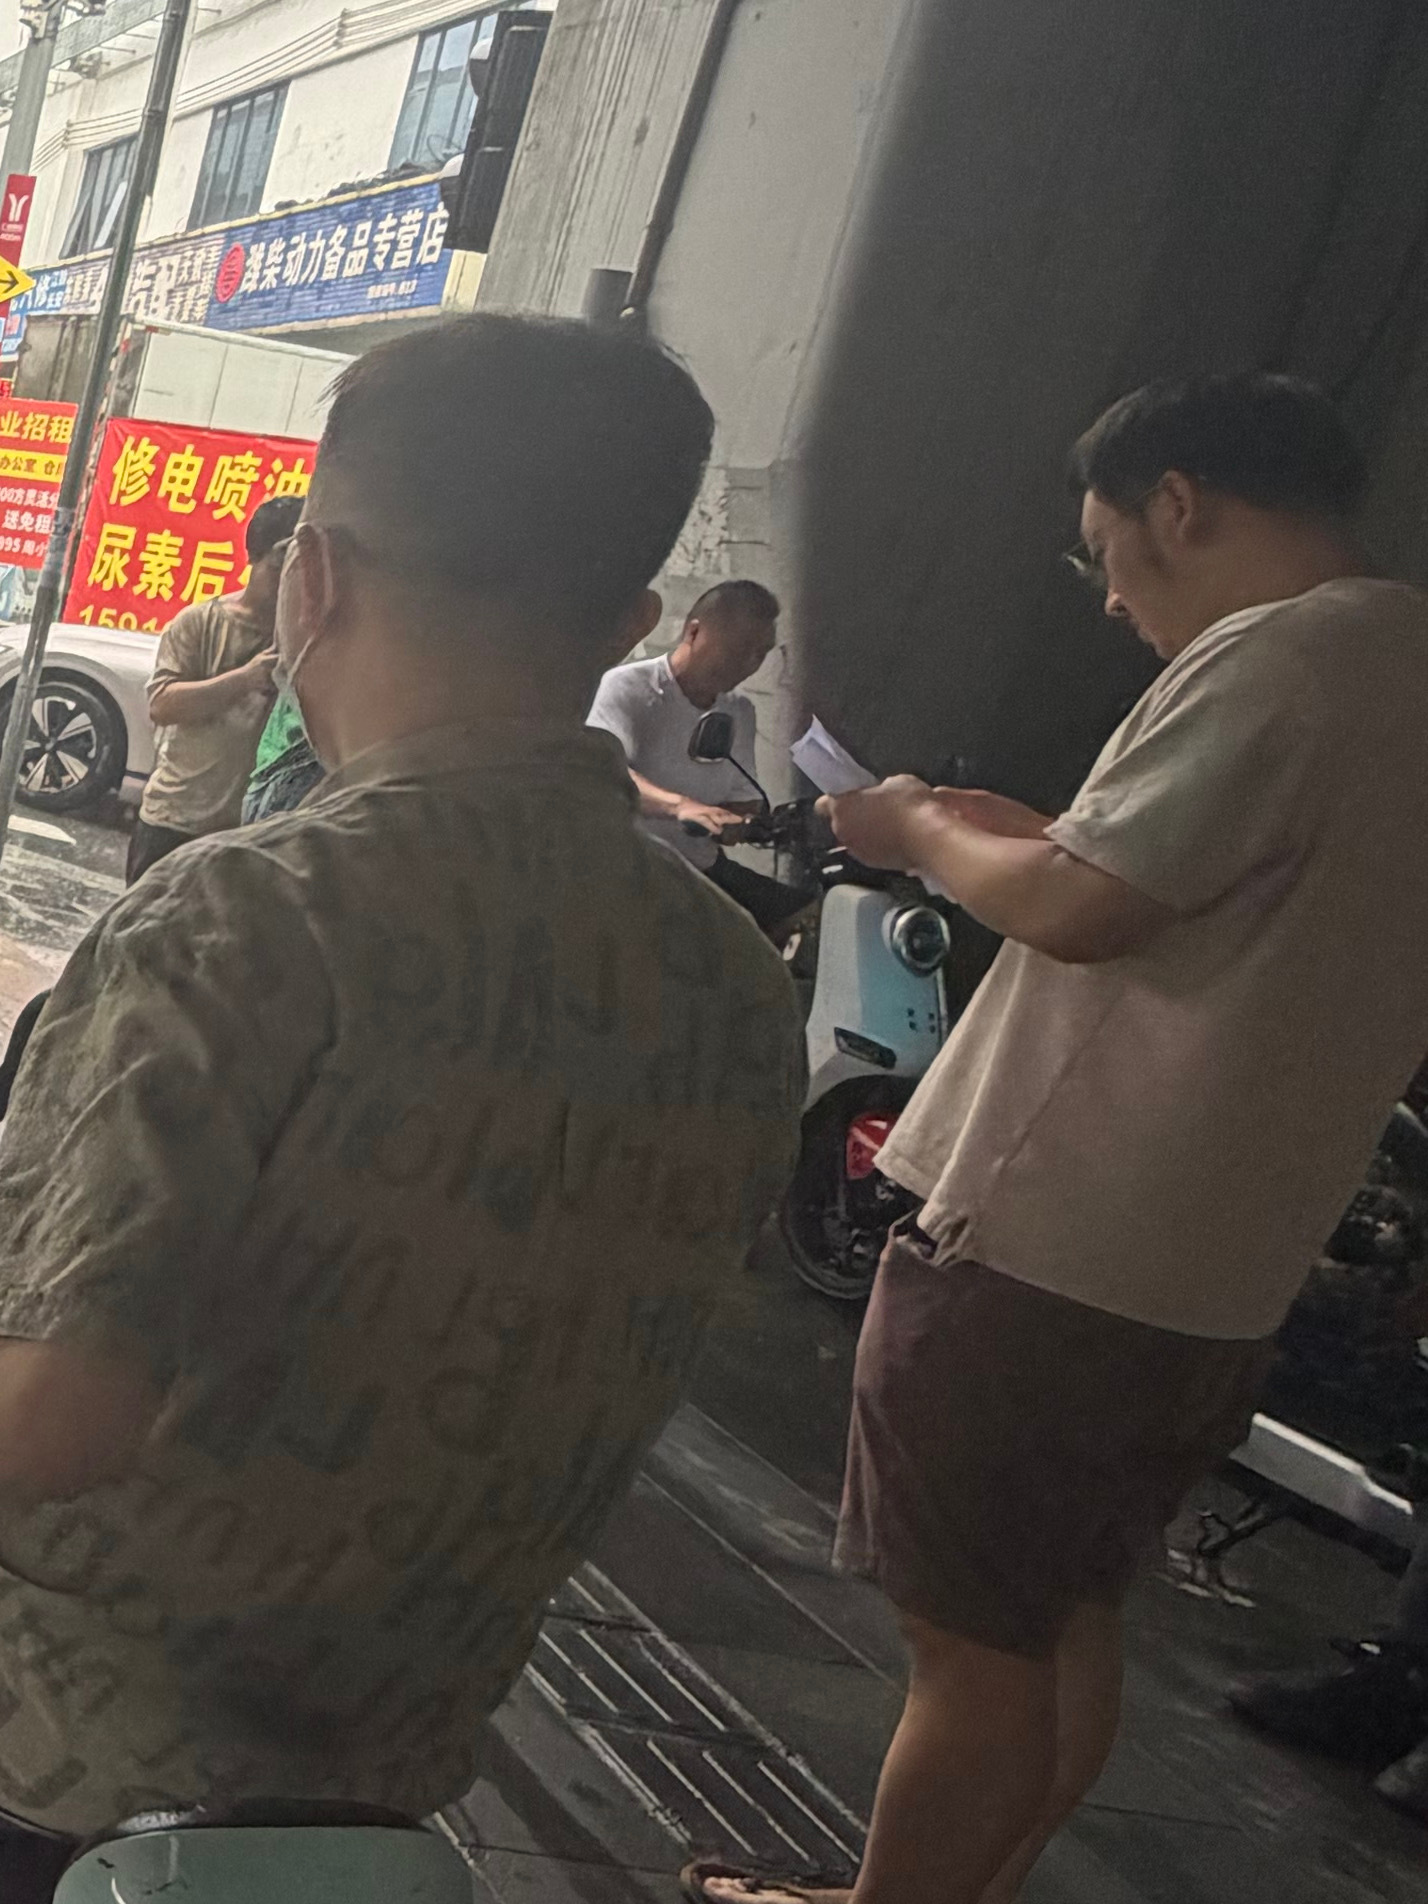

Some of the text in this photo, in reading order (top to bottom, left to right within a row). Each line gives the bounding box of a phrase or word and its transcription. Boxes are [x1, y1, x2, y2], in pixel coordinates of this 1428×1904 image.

[109, 435, 313, 523] 修电喷油
[87, 522, 253, 605] 尿素后
